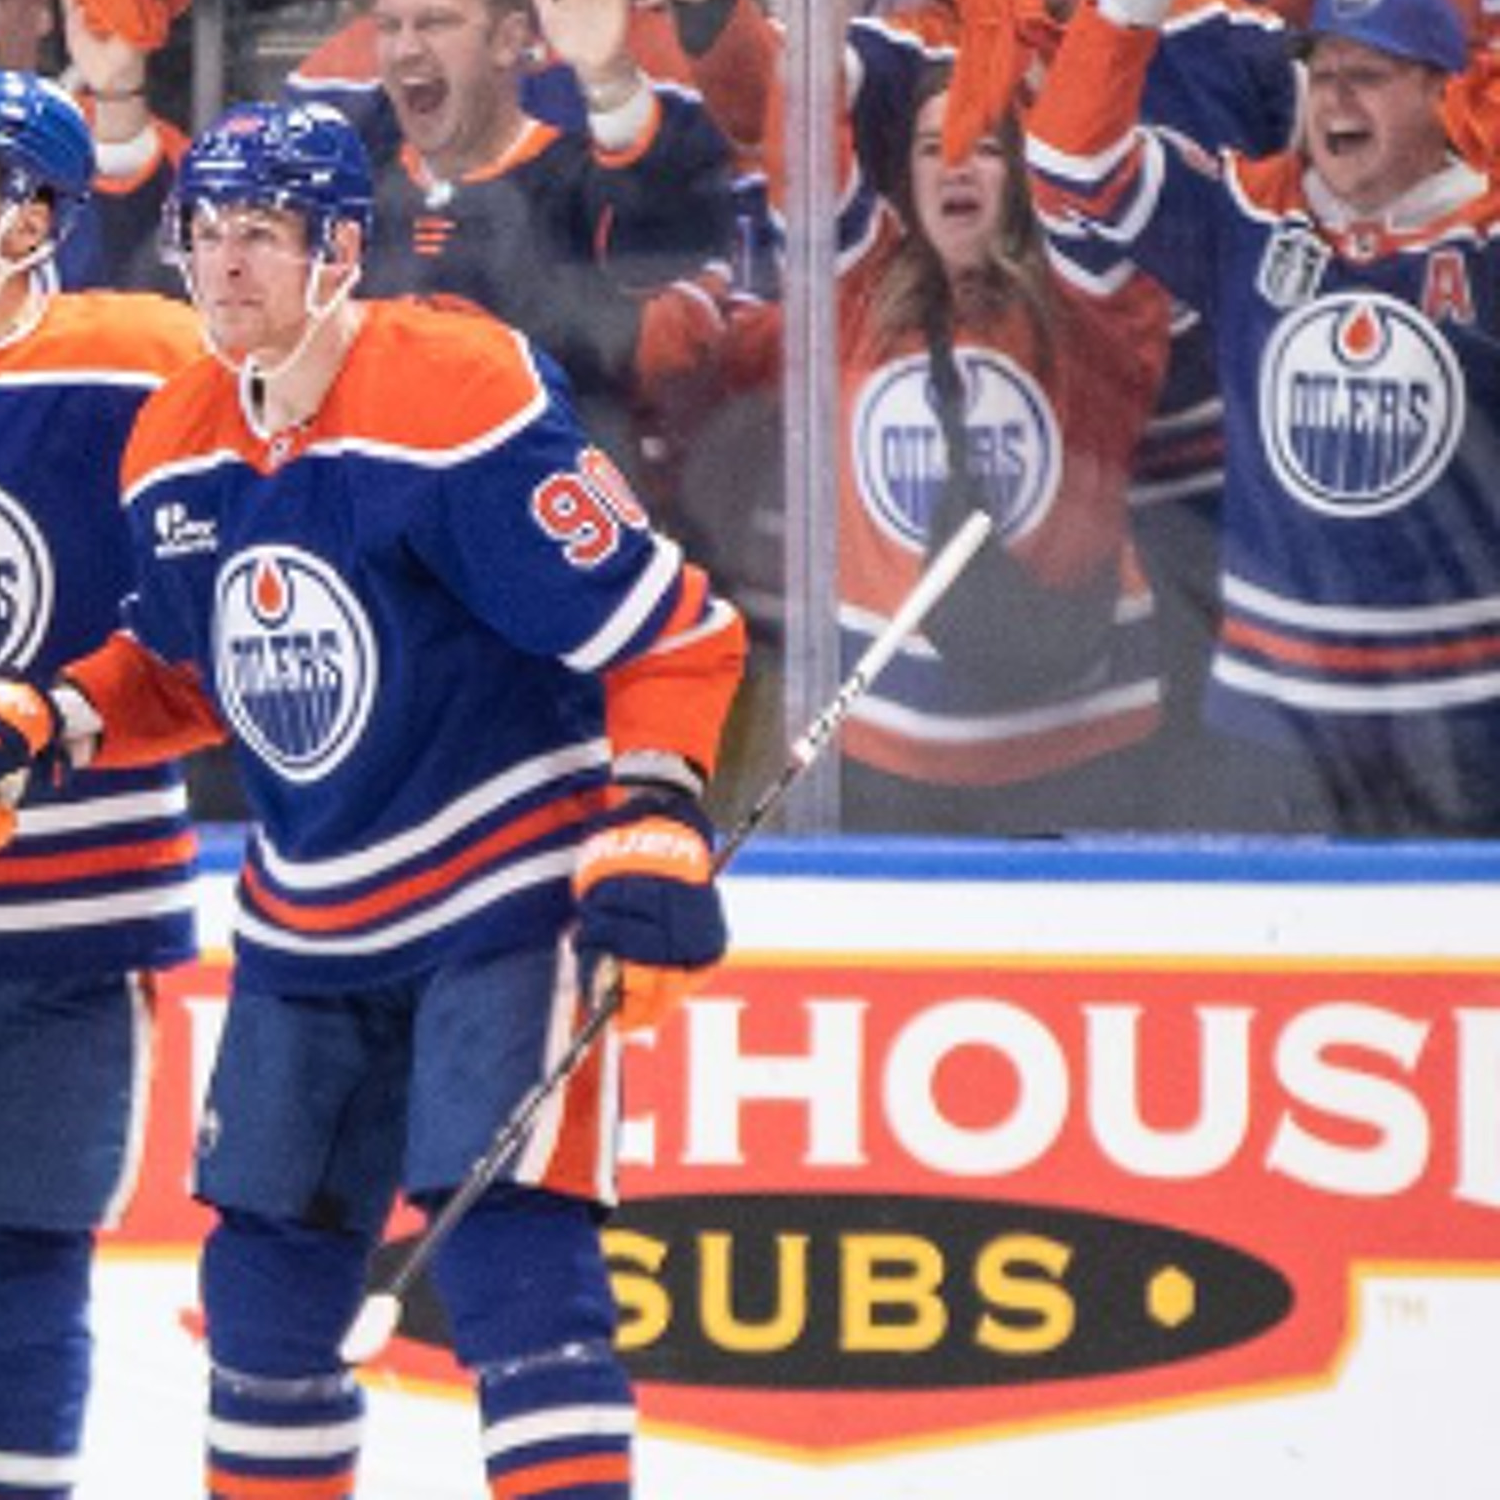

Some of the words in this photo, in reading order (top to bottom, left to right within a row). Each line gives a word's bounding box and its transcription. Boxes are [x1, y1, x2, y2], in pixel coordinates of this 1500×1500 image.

[1420, 248, 1474, 325] A
[1291, 370, 1432, 434] OILERS
[231, 629, 343, 692] OILERS
[606, 1232, 1078, 1356] SUBS
